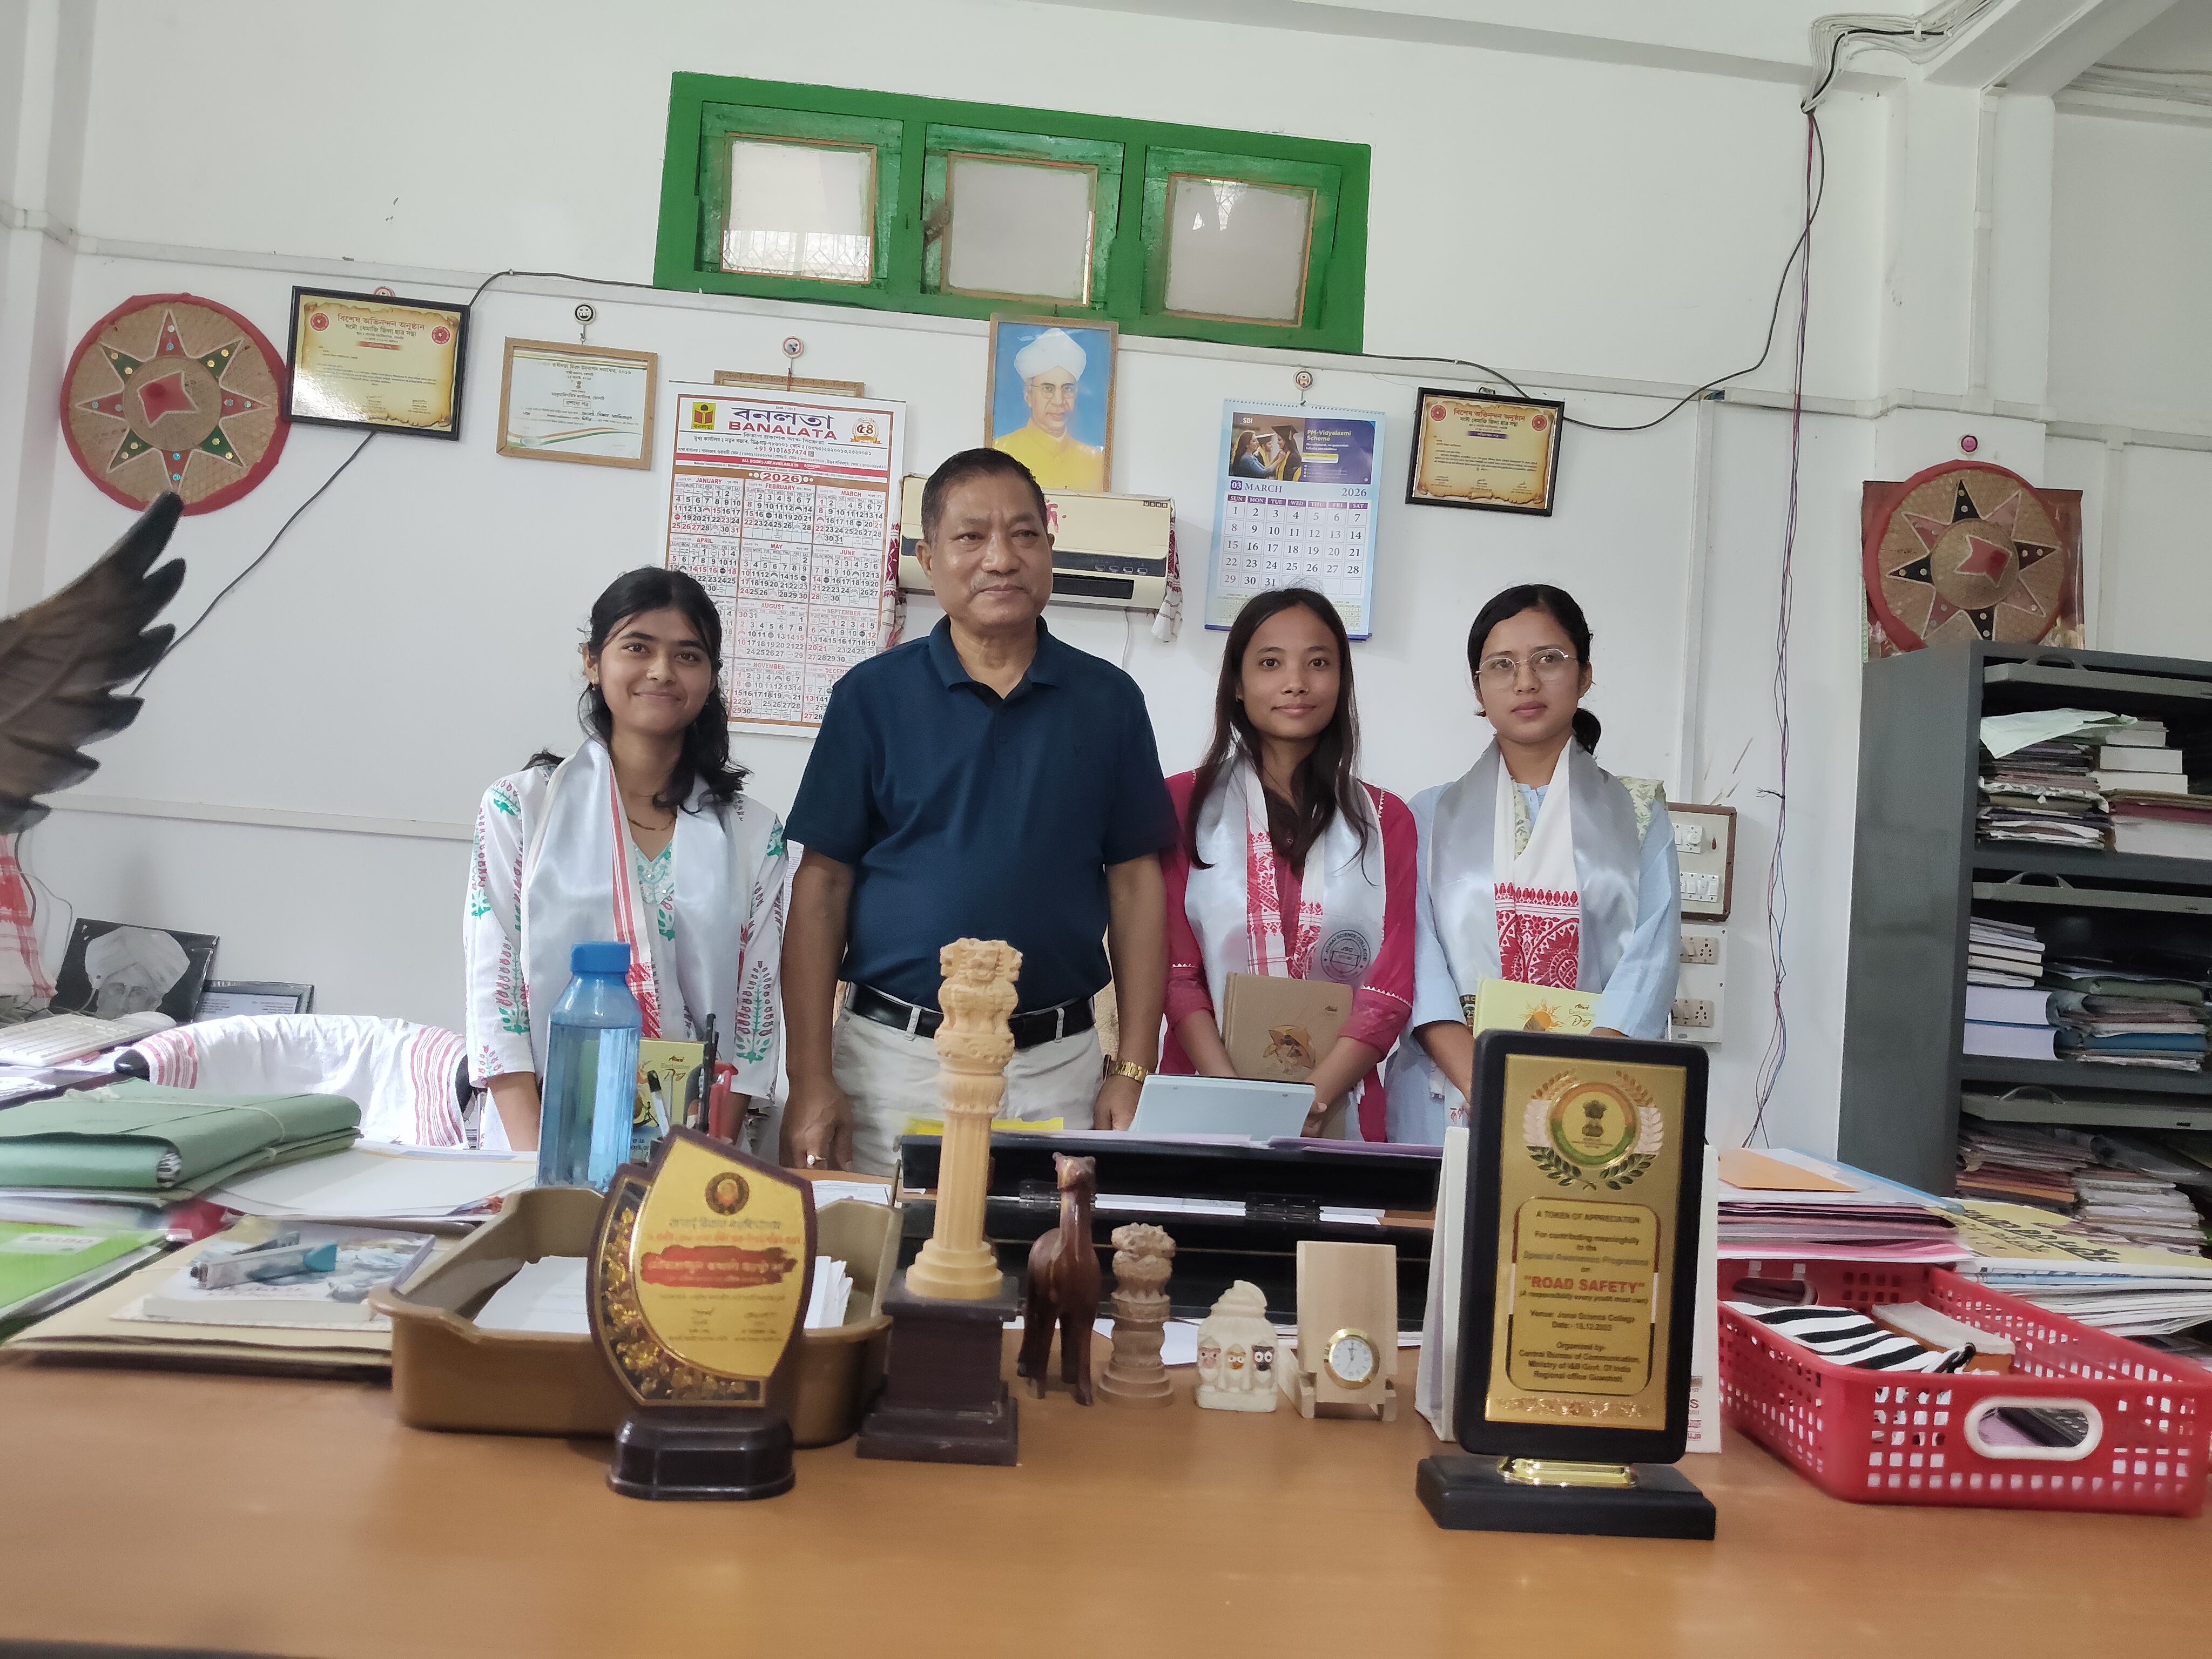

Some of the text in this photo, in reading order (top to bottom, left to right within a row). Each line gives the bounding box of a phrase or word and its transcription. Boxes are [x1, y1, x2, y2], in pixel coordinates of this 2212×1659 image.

[338, 313, 425, 331] বিশেষ অভিনন্দন অনুষ্ঠান
[730, 407, 835, 430] বনলতা
[729, 421, 837, 440] BANALATA
[768, 447, 807, 456] 9101657474
[763, 473, 799, 483] 2026
[1244, 483, 1283, 493] MARCH
[1341, 488, 1367, 497] 2026
[1252, 508, 1258, 516] 2
[1313, 512, 1319, 521] 5
[1334, 513, 1340, 521] 6
[1354, 514, 1360, 522] 7
[1231, 523, 1361, 539] 8 9 10 11 12 13 14
[1228, 541, 1360, 556] 15 16 17 18 19 20 21
[1225, 558, 1359, 574] 22 23 24 25 26 27 28
[1225, 575, 1275, 586] 29 30 31
[1325, 939, 1337, 954] JONAI
[1357, 936, 1368, 961] COLLEGE
